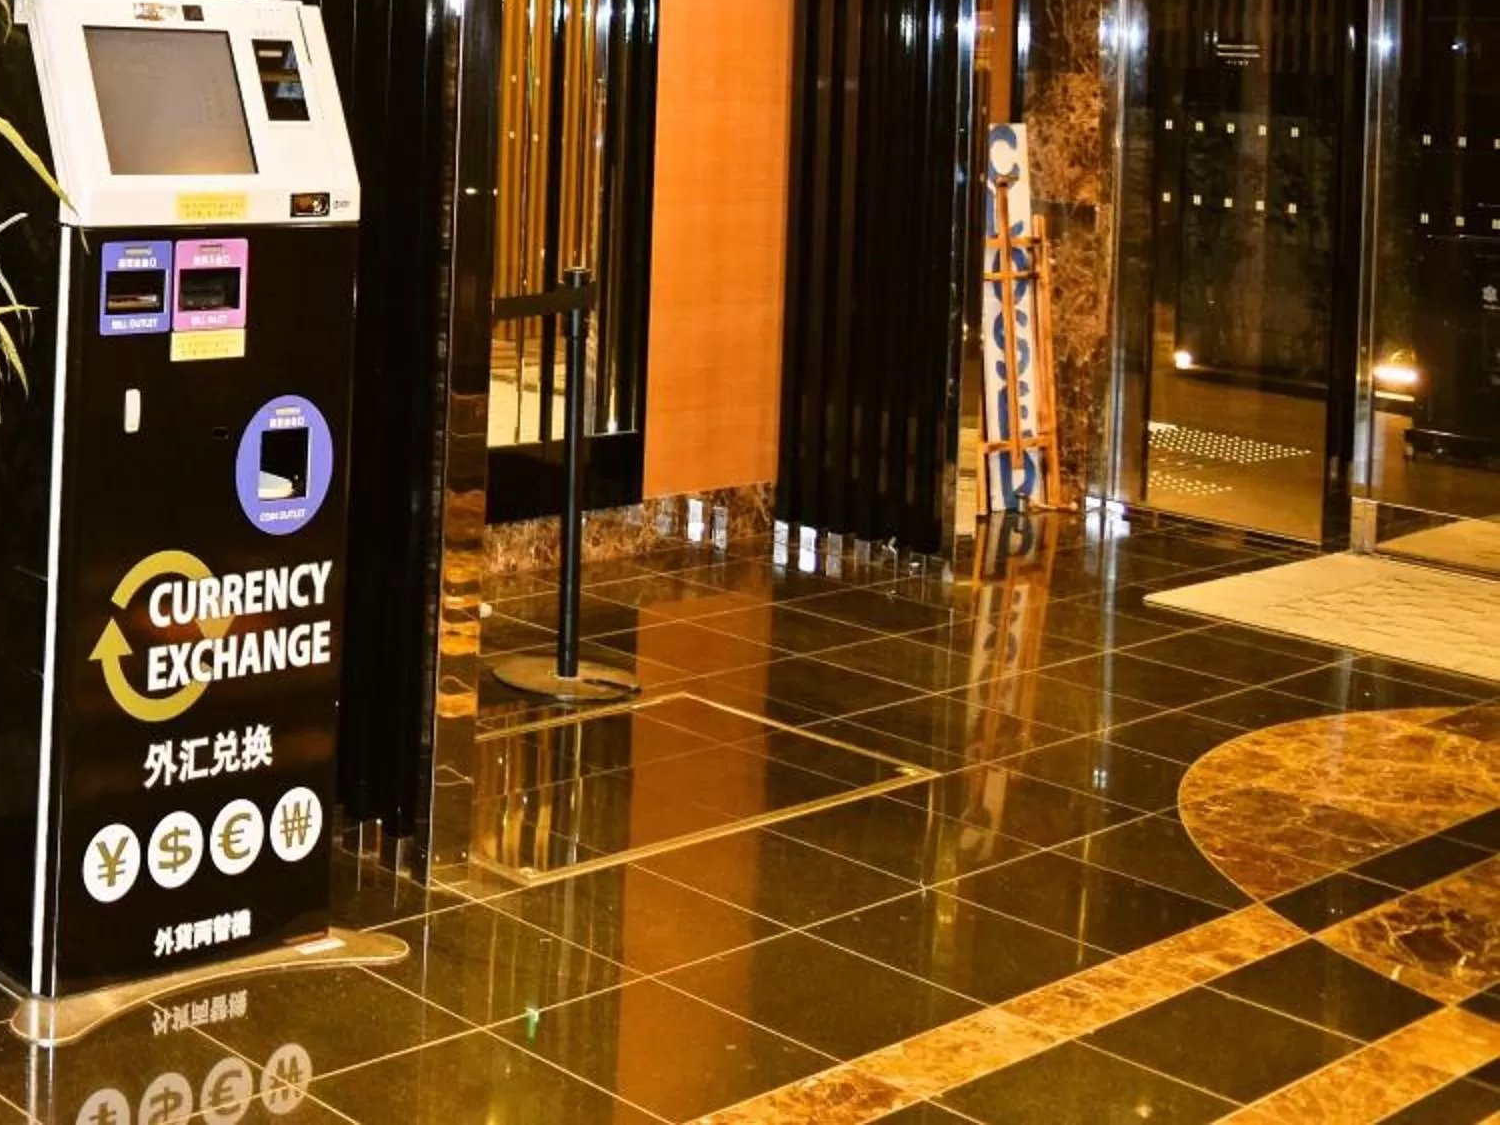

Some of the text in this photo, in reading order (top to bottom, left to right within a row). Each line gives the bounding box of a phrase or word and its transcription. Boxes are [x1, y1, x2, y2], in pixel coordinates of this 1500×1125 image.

[148, 560, 333, 629] CURRENCY
[147, 620, 332, 692] EXCHANGE
[142, 723, 273, 789] 外汇兑换
